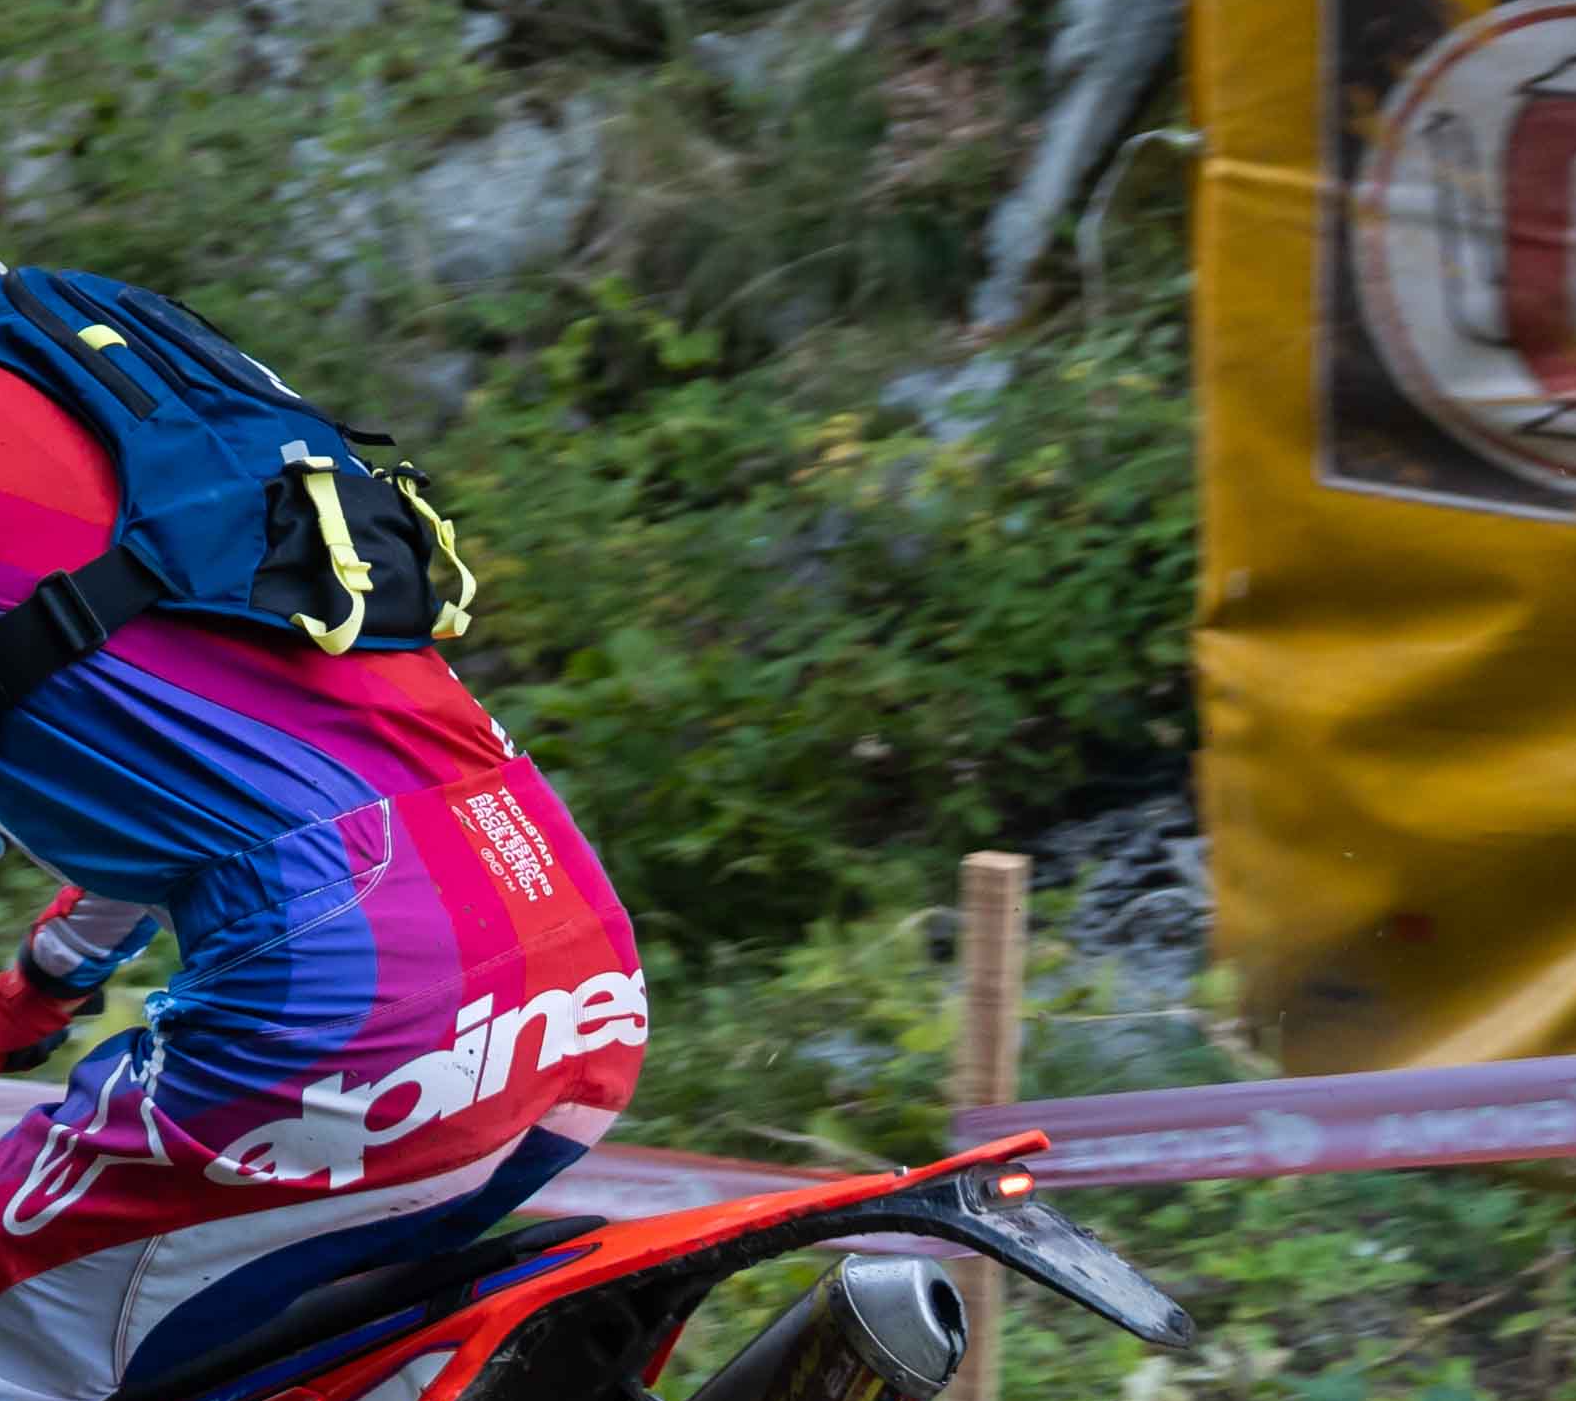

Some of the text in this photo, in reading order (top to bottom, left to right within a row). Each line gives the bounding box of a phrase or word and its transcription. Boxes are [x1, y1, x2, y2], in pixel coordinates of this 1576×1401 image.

[465, 797, 539, 902] PRODUCTION
[474, 794, 509, 837] RACE
[483, 792, 554, 897] ALPINESTARS
[498, 785, 554, 867] TECHSTAR
